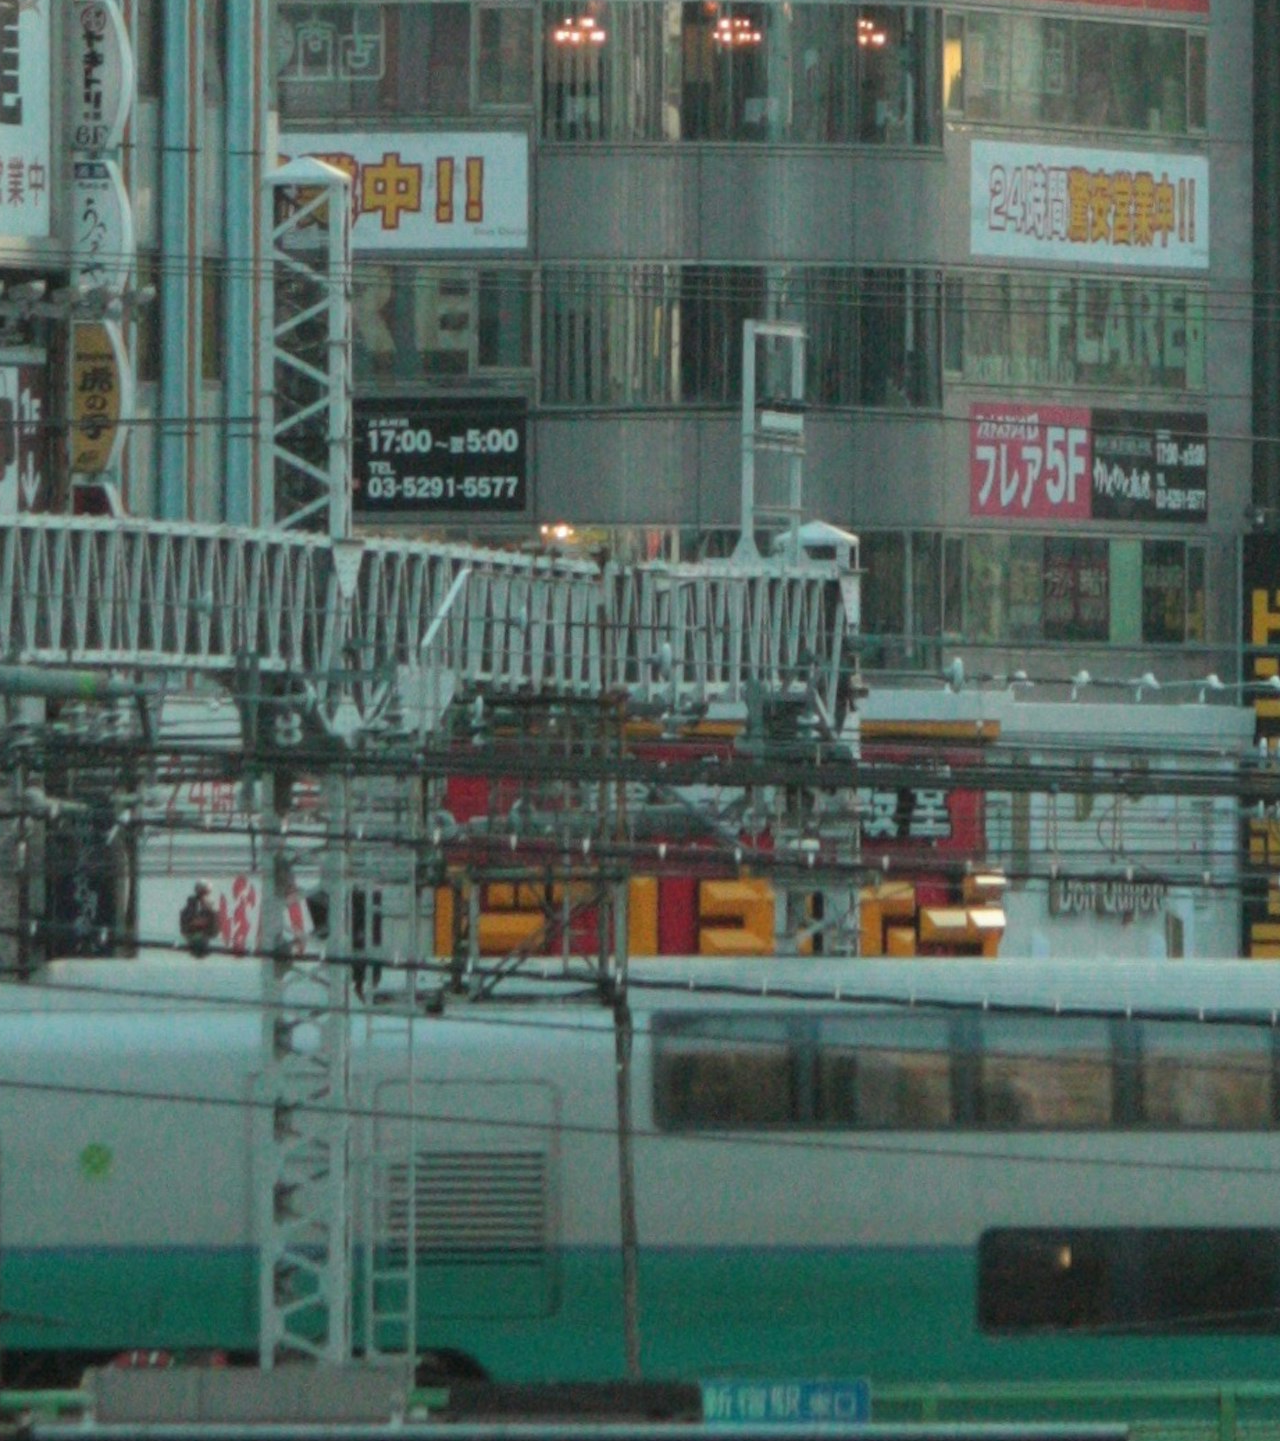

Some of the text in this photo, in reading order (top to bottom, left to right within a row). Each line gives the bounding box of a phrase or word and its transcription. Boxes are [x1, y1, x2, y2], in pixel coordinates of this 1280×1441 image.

[368, 476, 518, 498] 03-5291-5577
[976, 444, 1044, 509] フレア
[1045, 426, 1087, 504] 5F
